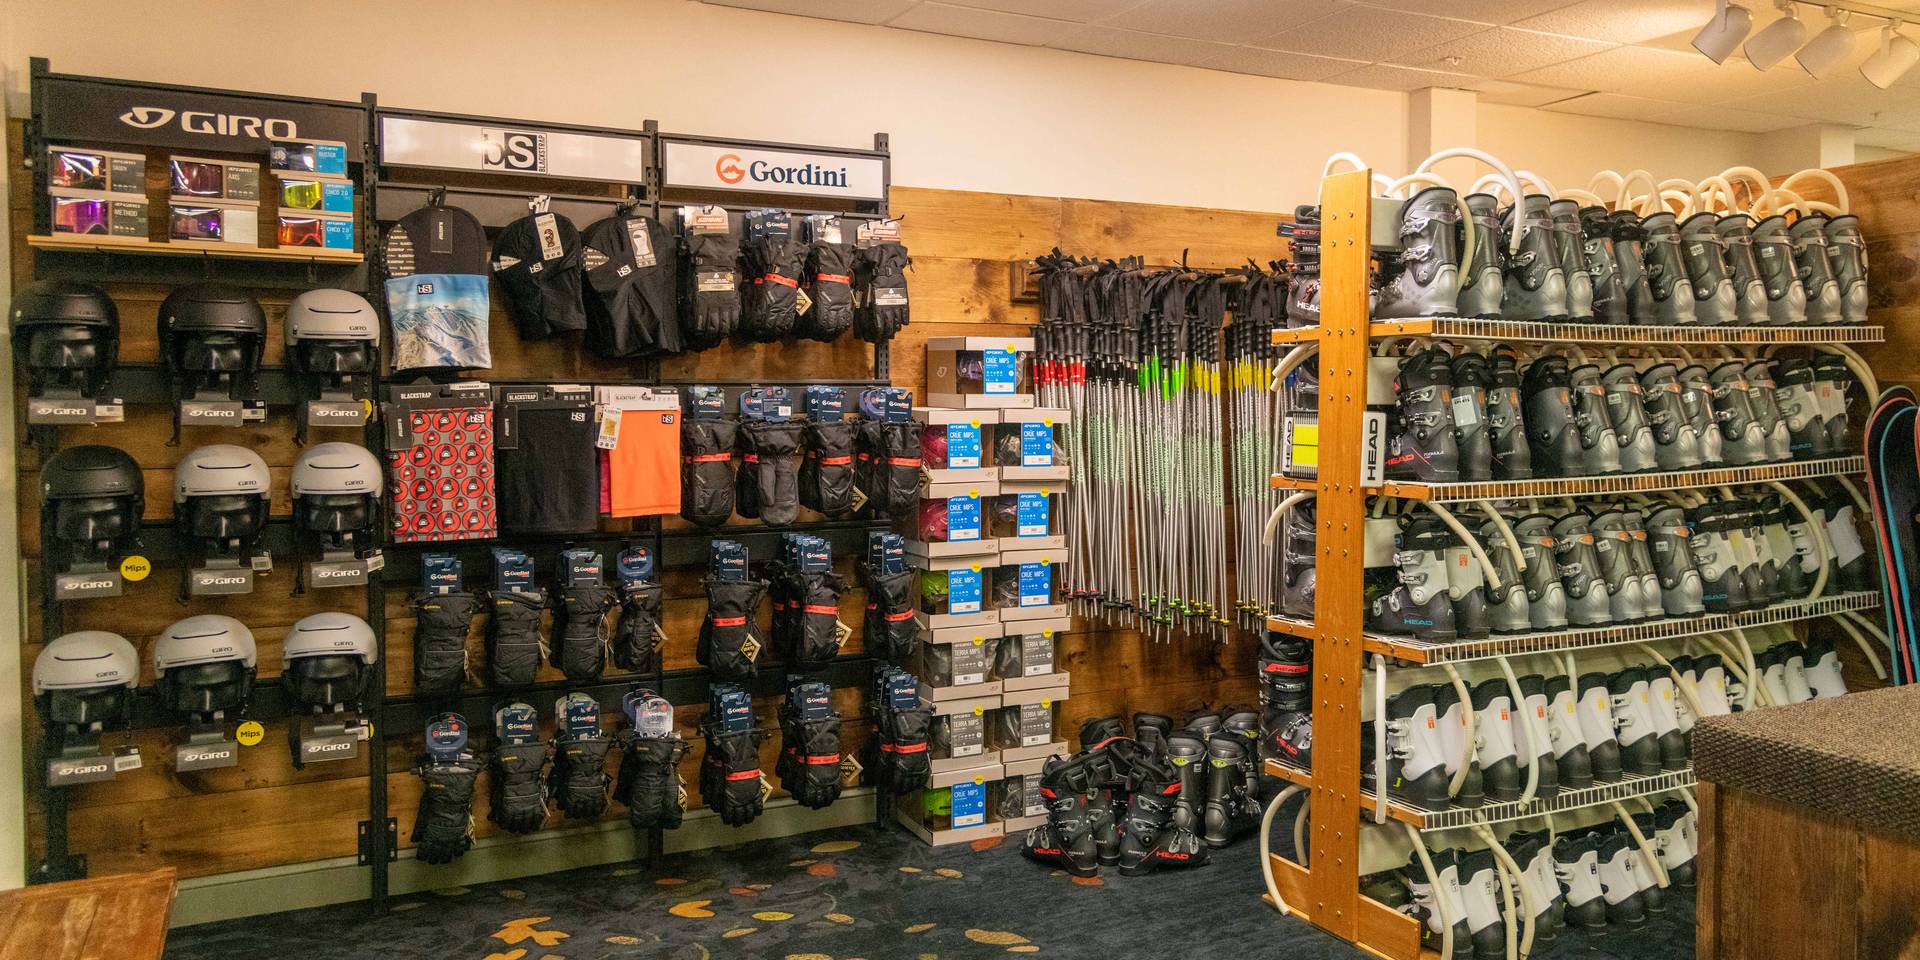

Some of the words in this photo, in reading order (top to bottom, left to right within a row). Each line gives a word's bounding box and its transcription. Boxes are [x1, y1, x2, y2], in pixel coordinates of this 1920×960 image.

[182, 111, 297, 139] GIRO
[538, 134, 546, 173] BLACKSTRAP
[750, 160, 848, 188] Gordini
[114, 208, 138, 217] METHOD
[400, 392, 432, 400] BLACKSTRAP
[54, 407, 87, 416] GIRO
[204, 409, 235, 418] GIRO
[330, 409, 359, 418] GIRO
[1286, 420, 1294, 468] HEAD
[1367, 418, 1378, 482] HEAD
[125, 564, 147, 573] Mips
[332, 569, 361, 578] GIRO
[80, 580, 113, 589] GIRO
[214, 576, 246, 586] GIRO
[1404, 618, 1434, 626] HEAD
[954, 648, 969, 657] TERRA
[953, 719, 968, 728] TERRA
[240, 729, 261, 738] Mips
[322, 743, 351, 752] GIRO
[1276, 736, 1298, 756] HEAD
[200, 751, 230, 760] GIRO
[75, 764, 107, 774] GIRO
[1156, 851, 1190, 860] HEAD
